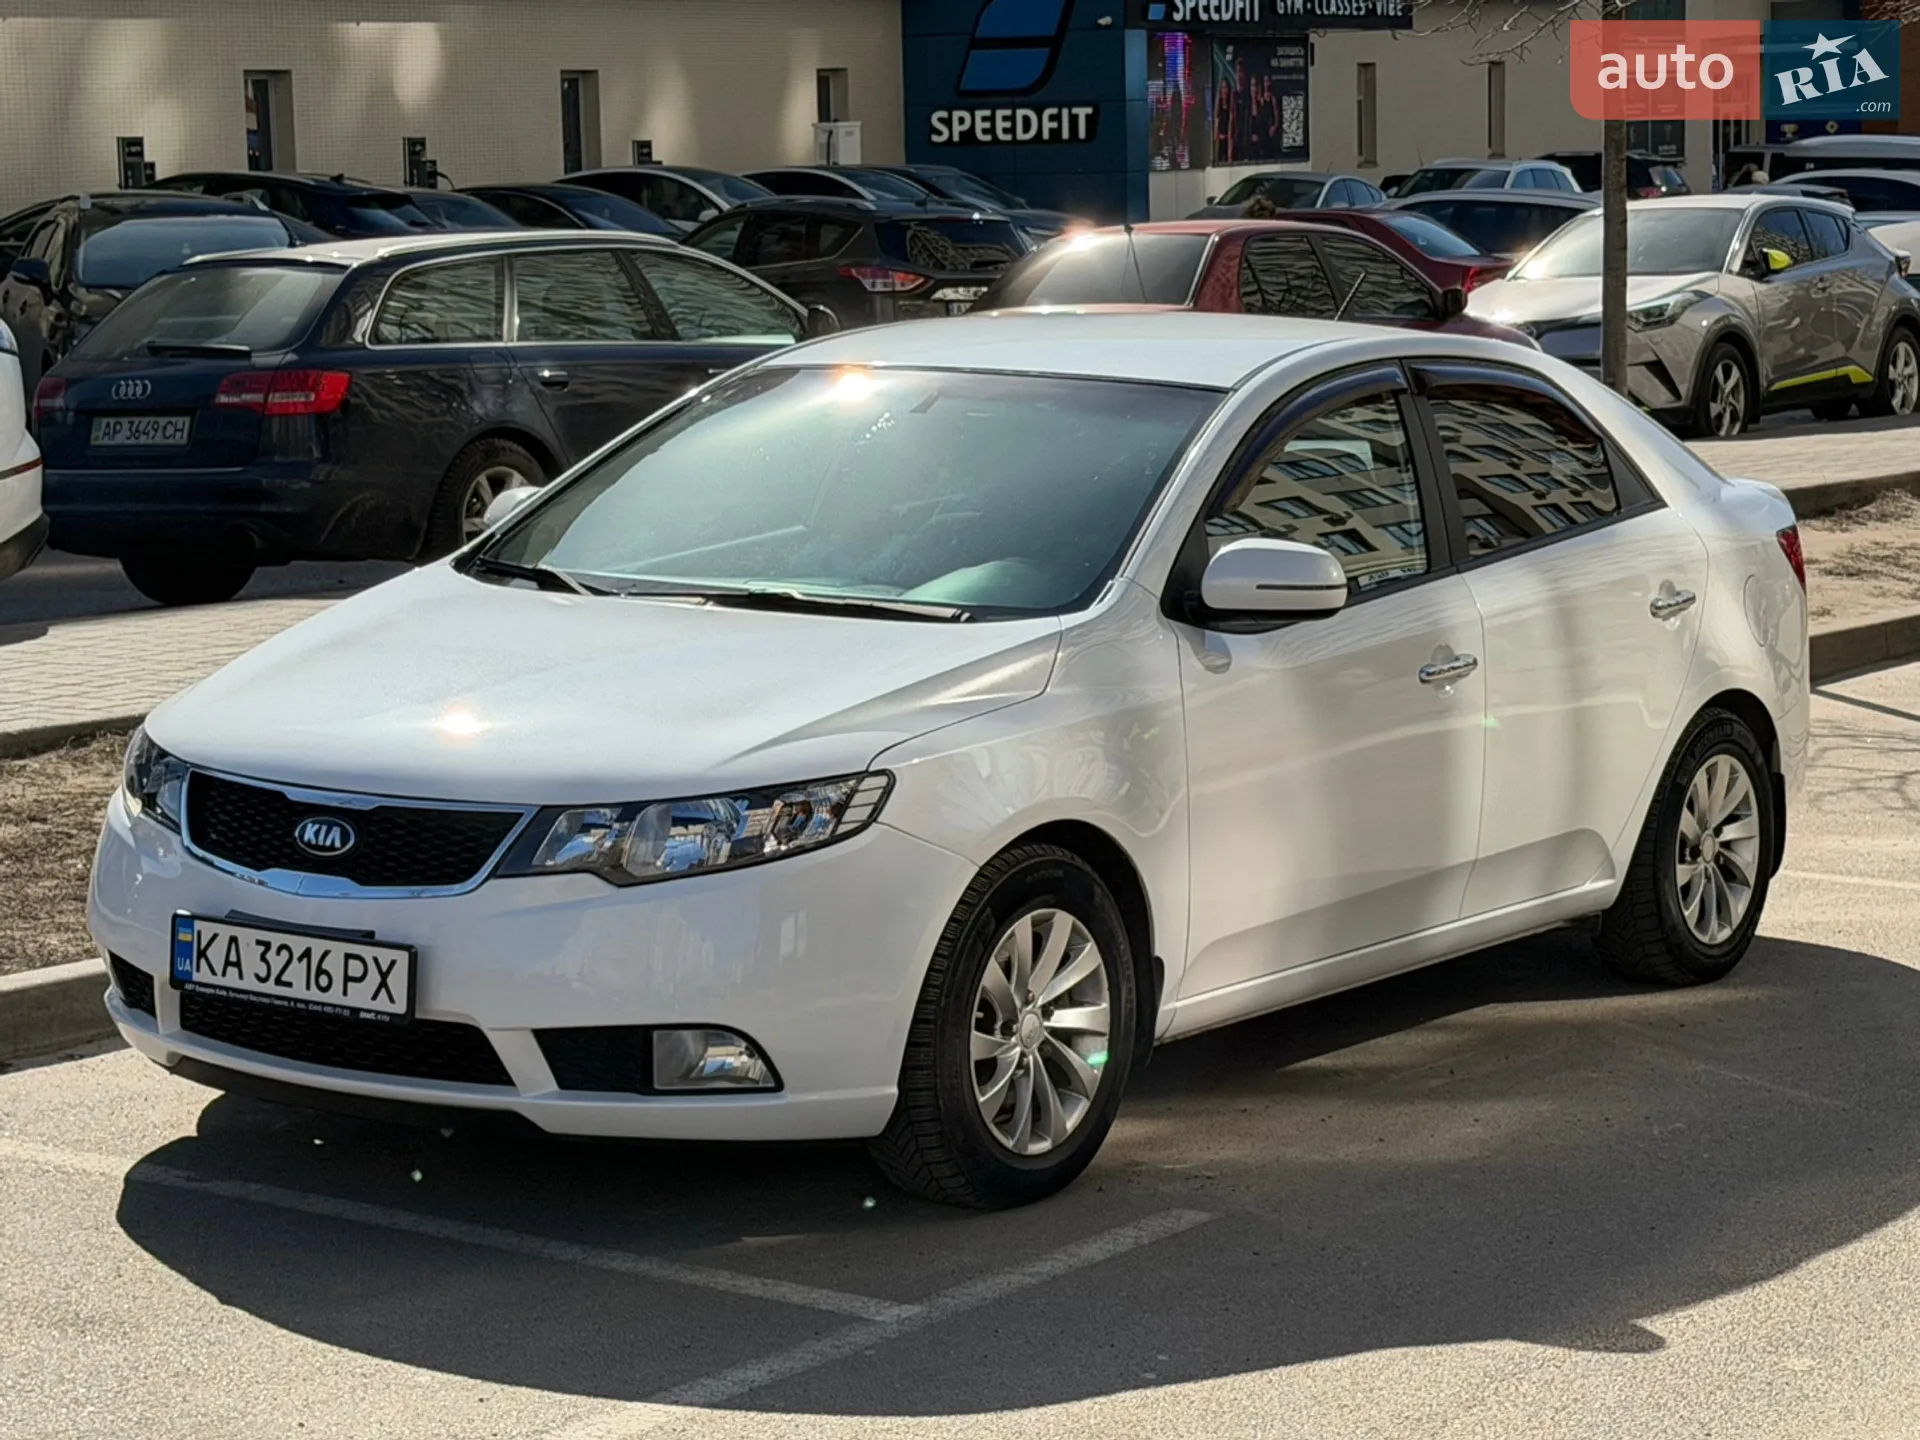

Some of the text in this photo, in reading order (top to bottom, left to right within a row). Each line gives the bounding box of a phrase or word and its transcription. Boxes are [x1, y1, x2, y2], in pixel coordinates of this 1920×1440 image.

[1172, 0, 1259, 22] SPEEDFIT
[930, 107, 1094, 143] SPEEDFIT
[303, 822, 341, 848] KIA
[177, 956, 192, 972] UA
[195, 929, 245, 981] KA
[253, 938, 334, 994] 3216
[342, 952, 398, 1005] PX
